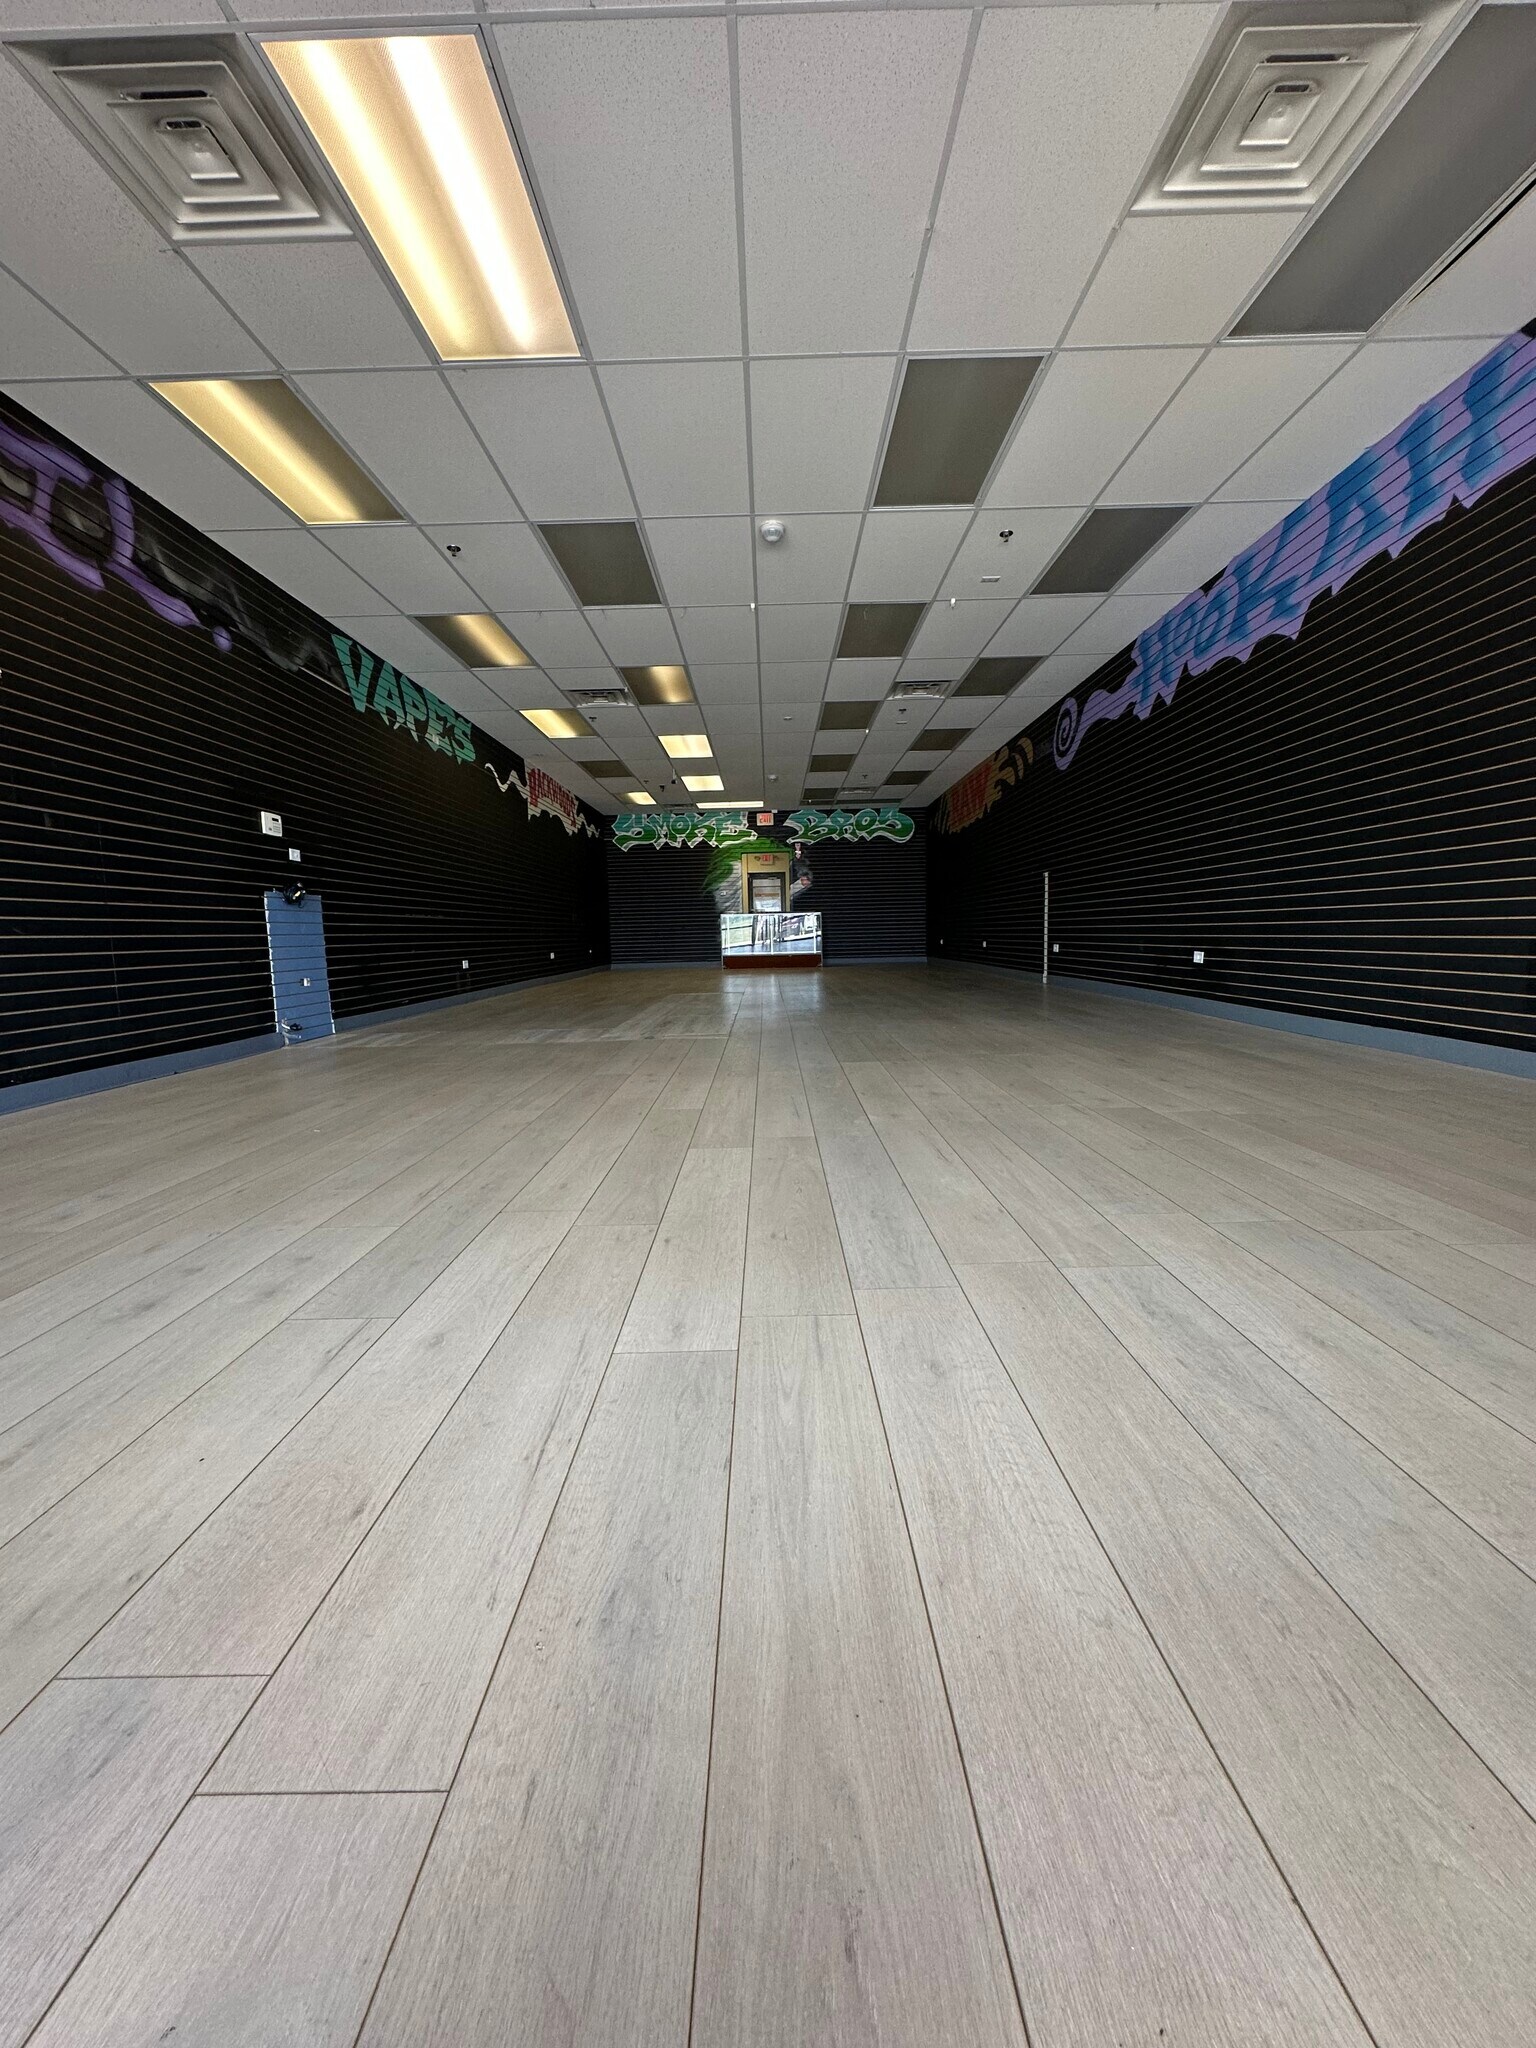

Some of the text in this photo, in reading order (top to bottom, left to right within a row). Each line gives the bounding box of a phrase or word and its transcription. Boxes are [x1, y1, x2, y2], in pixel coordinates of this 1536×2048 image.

[331, 633, 476, 765] VAPES
[611, 808, 915, 852] SMOKE BROS
